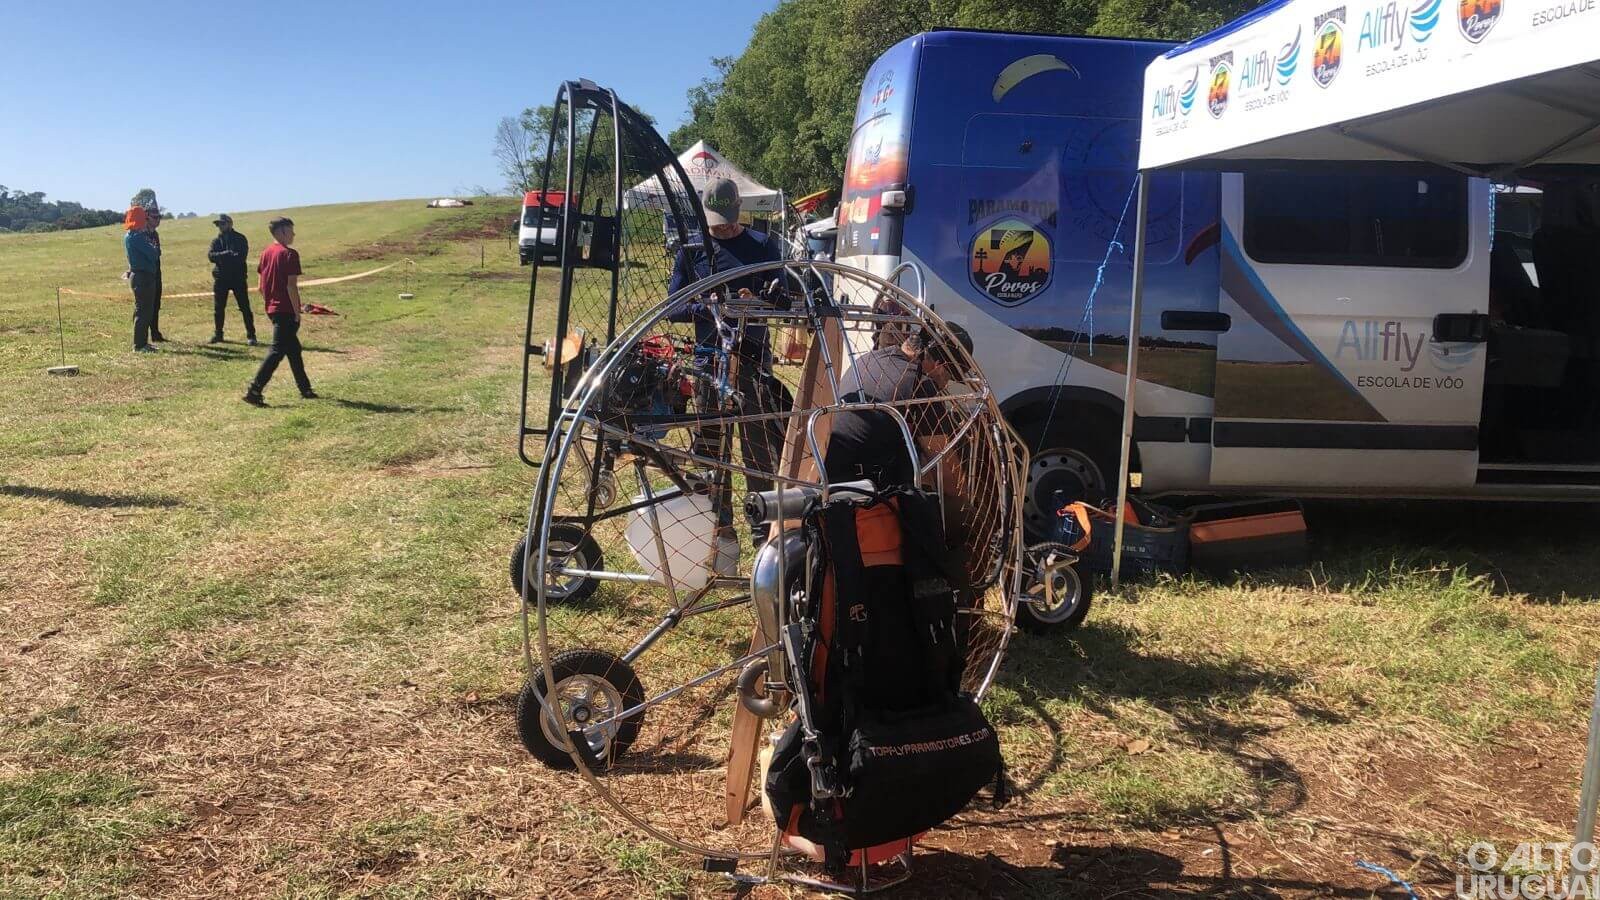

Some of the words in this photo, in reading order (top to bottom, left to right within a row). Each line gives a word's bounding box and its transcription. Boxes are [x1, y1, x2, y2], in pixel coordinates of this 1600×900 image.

[1358, 1, 1409, 52] Allfly
[1532, 2, 1577, 27] ESCOLA
[1238, 49, 1277, 92] Allfly
[985, 272, 1041, 293] Povos
[1335, 319, 1425, 372] Allfly
[1357, 376, 1410, 388] ESCOLA
[1413, 377, 1431, 388] DE
[1435, 375, 1464, 389] VÔO
